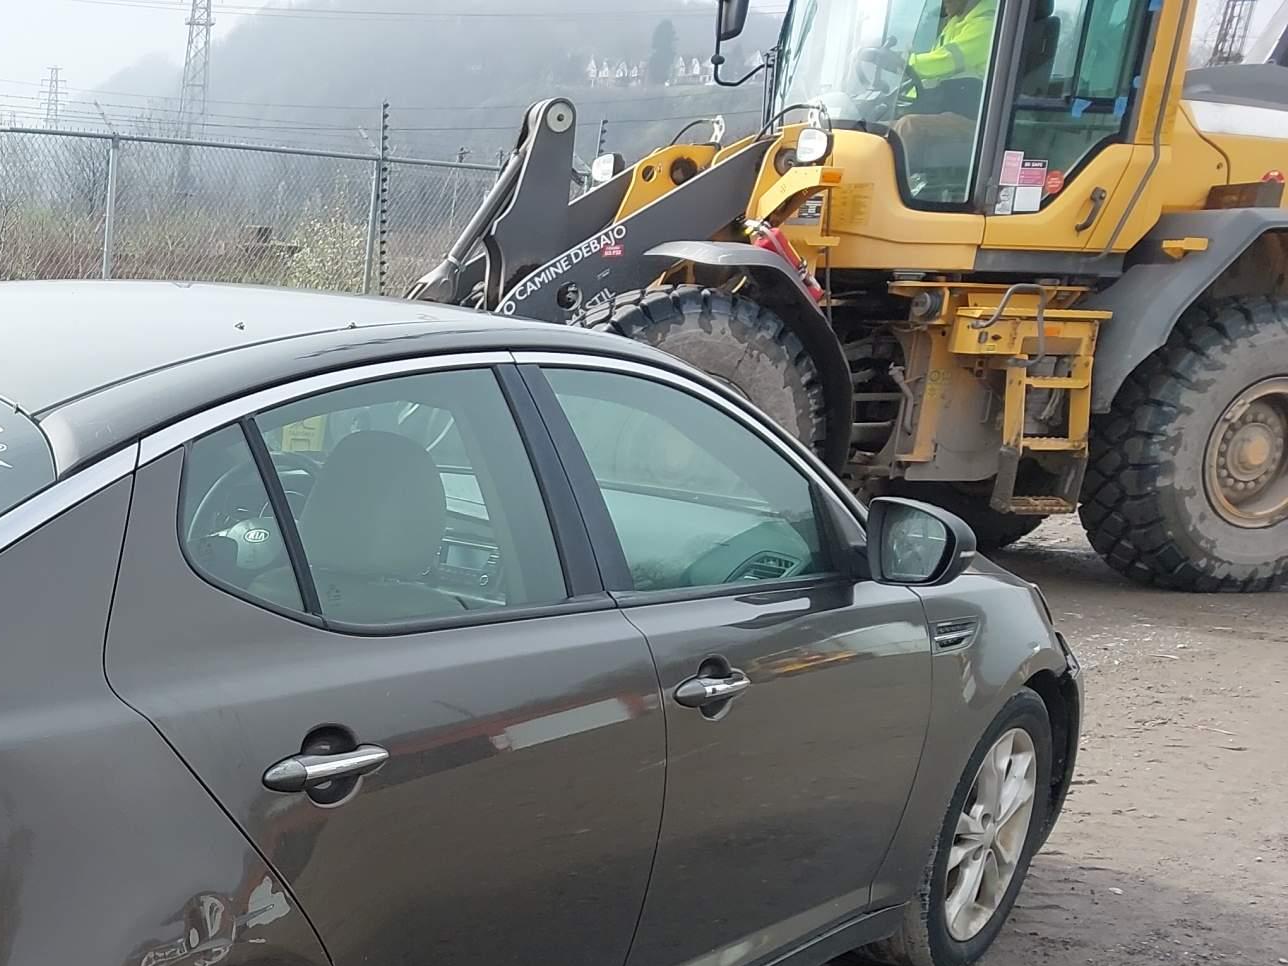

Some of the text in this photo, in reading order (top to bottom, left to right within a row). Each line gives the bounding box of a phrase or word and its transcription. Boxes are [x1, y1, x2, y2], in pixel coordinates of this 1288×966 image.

[515, 256, 572, 300] CAMINE
[571, 225, 626, 264] DEBAJO
[246, 530, 267, 541] KIA
